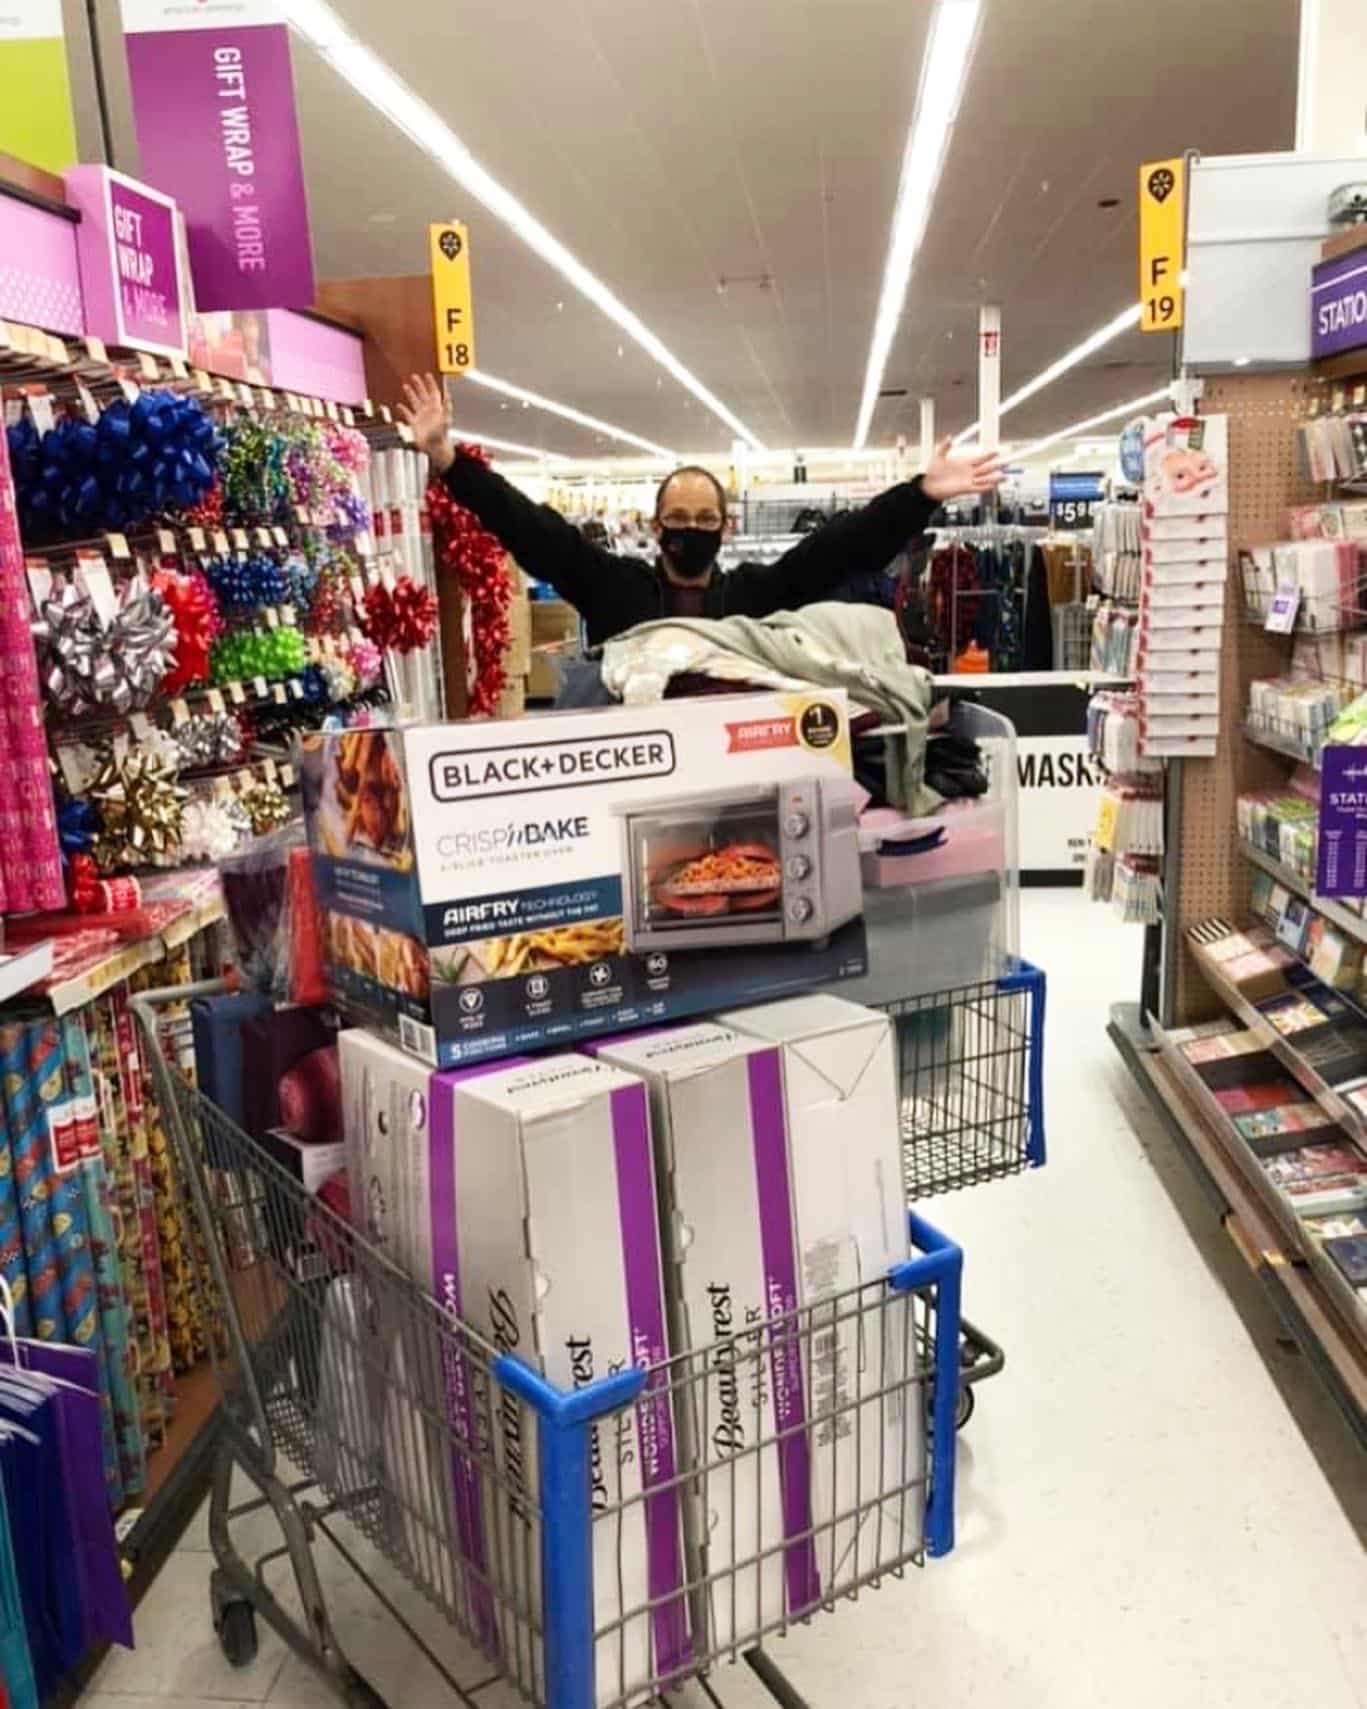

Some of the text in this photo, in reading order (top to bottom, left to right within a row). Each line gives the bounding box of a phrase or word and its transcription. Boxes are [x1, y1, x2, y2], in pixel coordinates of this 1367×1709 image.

[214, 47, 265, 270] GIFT WRAP & MORE
[115, 204, 142, 248] GIFT
[119, 243, 153, 286] WRAP
[1151, 257, 1169, 285] F
[447, 308, 462, 333] F
[1148, 296, 1174, 323] 19
[445, 343, 469, 366] 18
[443, 743, 664, 788] BLACK+DECKER
[443, 898, 519, 926] AIRFRY
